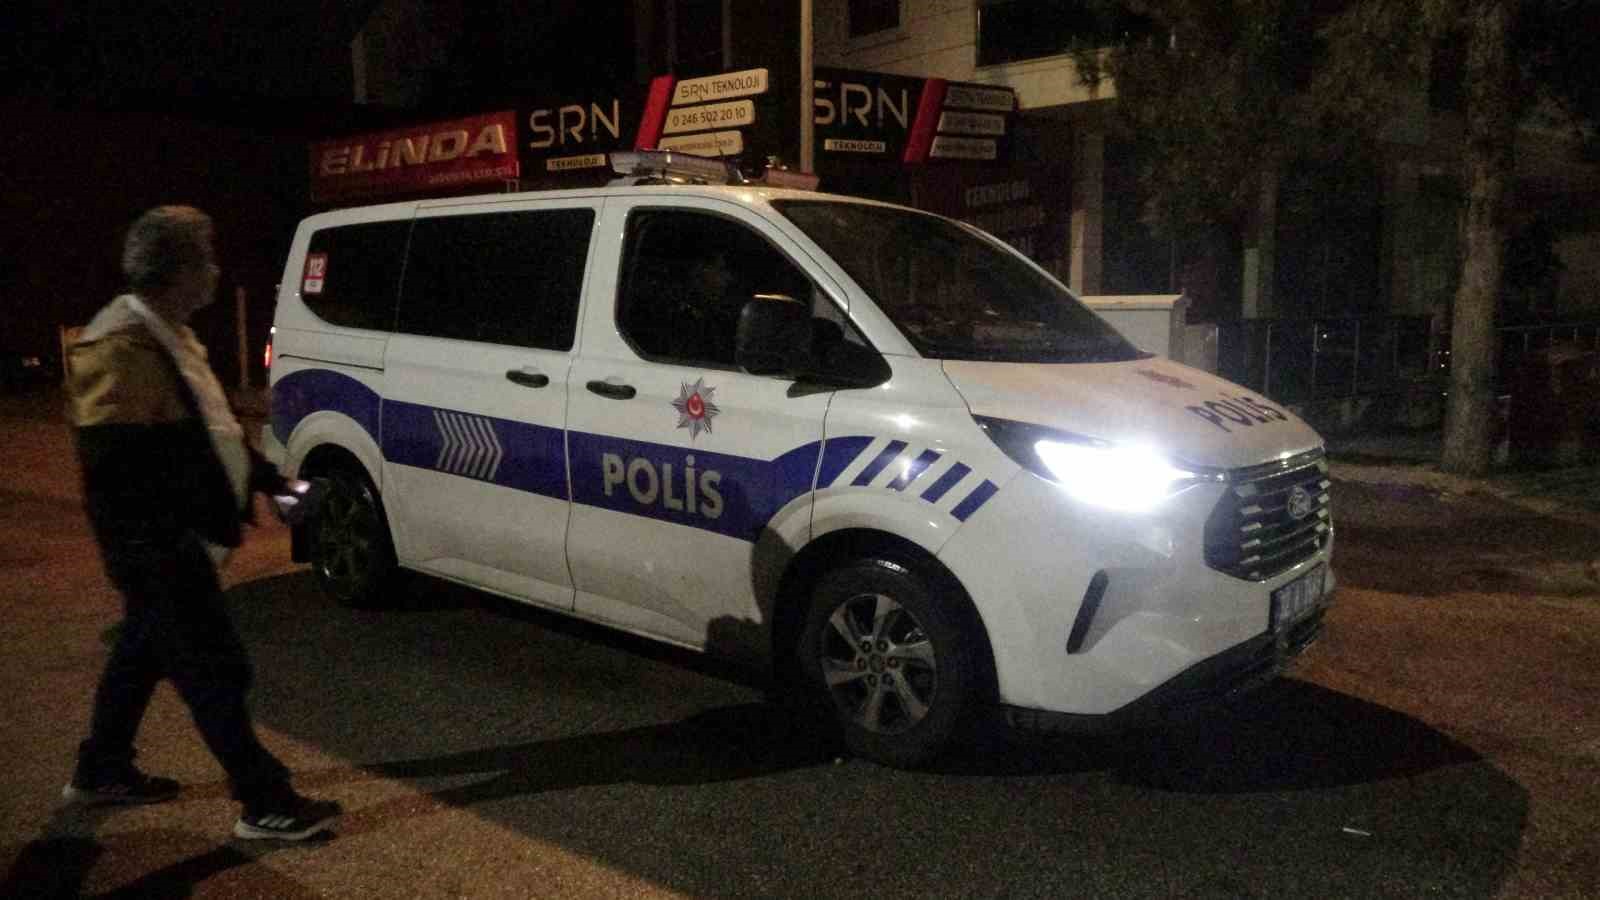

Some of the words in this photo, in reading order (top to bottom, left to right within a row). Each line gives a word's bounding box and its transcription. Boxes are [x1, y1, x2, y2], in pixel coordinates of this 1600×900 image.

[681, 82, 709, 98] SRN
[814, 79, 909, 129] SRN
[528, 97, 620, 149] SRN
[672, 115, 680, 127] 0
[682, 112, 699, 126] 246
[700, 110, 719, 122] 502
[720, 108, 733, 121] 20
[735, 106, 747, 120] 10
[602, 452, 724, 519] POLİS
